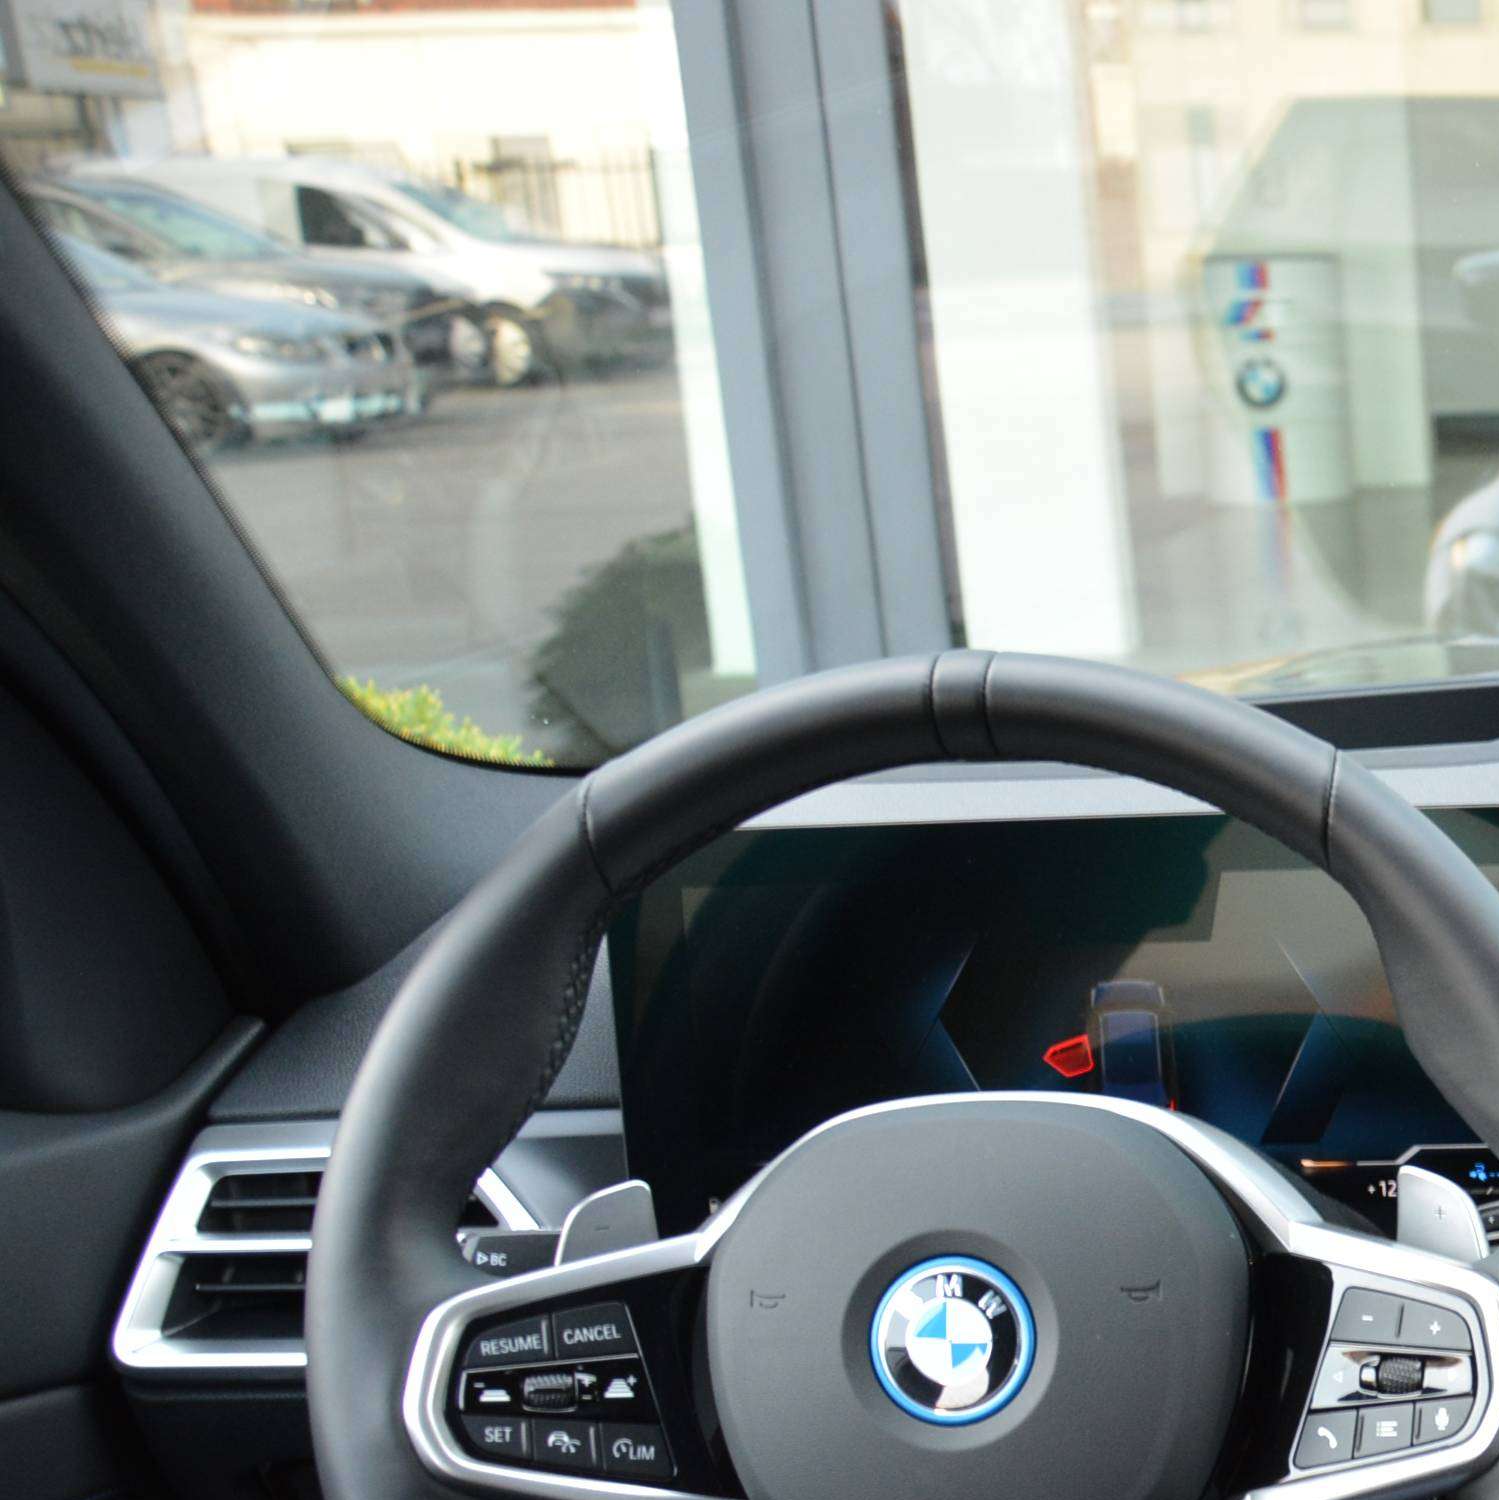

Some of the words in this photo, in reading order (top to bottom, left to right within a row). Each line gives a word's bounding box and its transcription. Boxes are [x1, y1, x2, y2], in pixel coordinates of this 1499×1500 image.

[490, 1253, 507, 1267] BC
[563, 1323, 622, 1345] CANCEL
[480, 1333, 542, 1356] RESUME
[484, 1426, 513, 1443] SET
[629, 1445, 656, 1461] LIM
